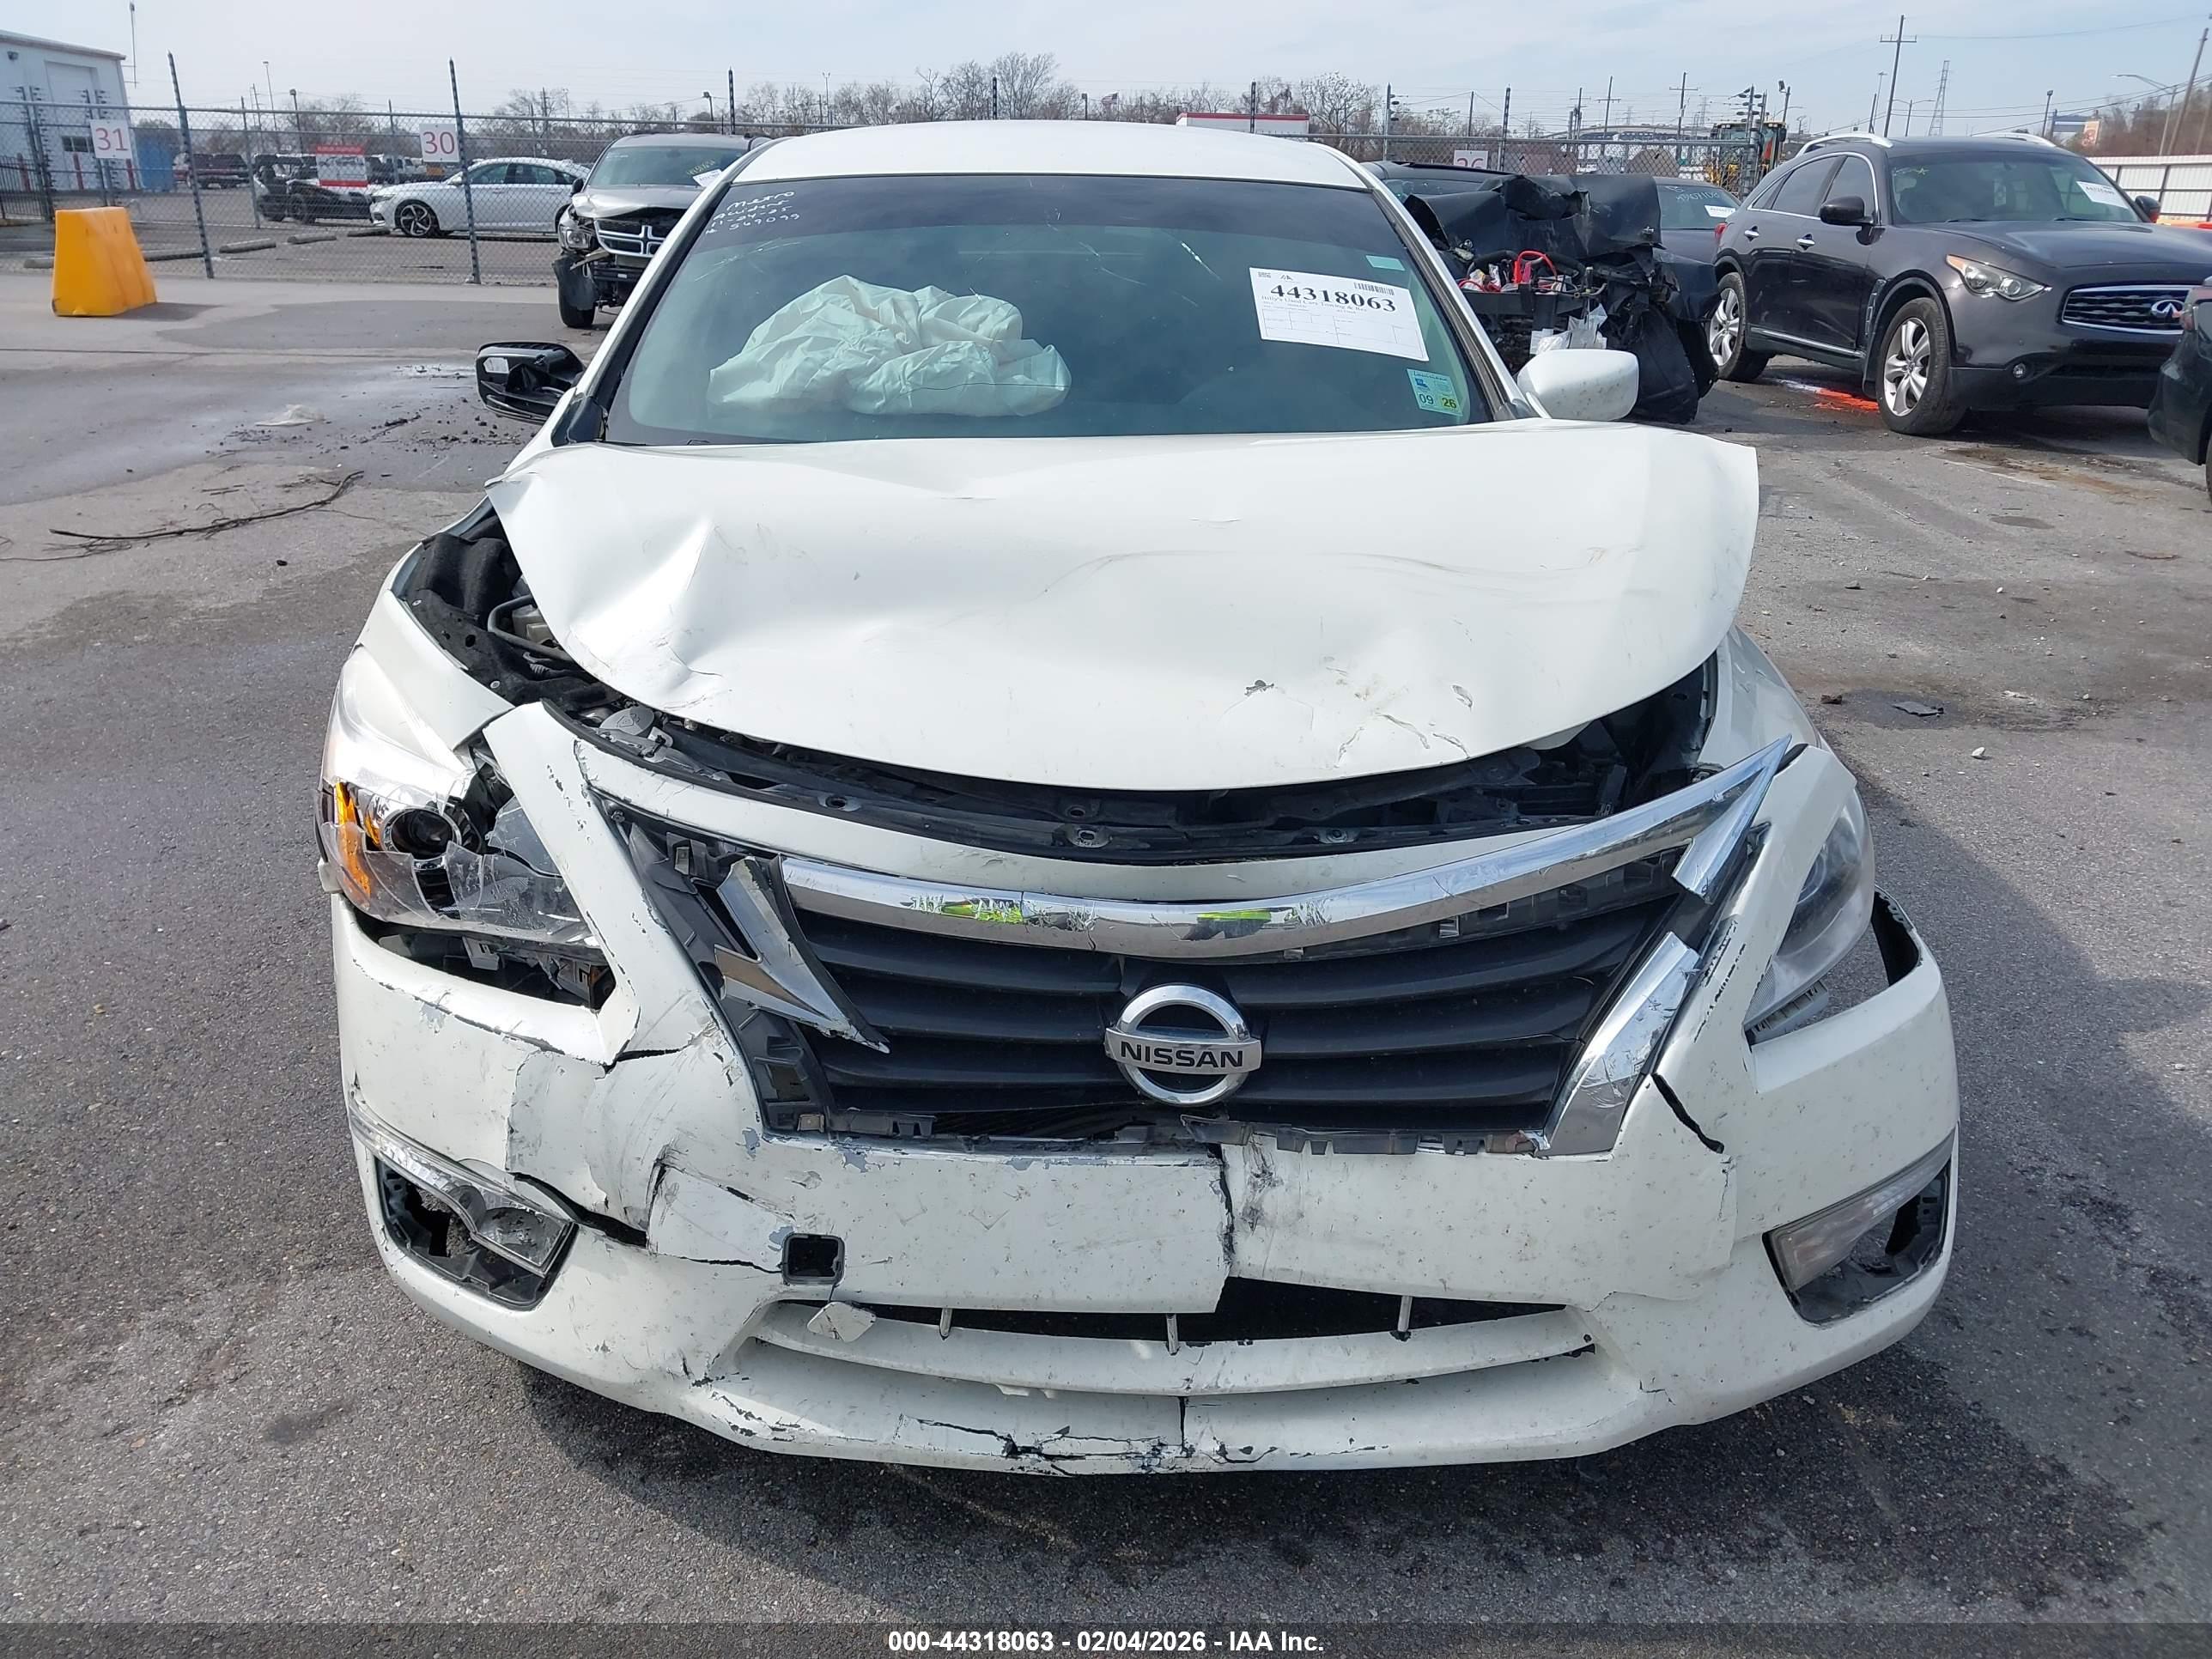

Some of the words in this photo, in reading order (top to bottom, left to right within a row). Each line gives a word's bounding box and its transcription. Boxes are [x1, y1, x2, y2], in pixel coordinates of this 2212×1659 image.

[94, 131, 128, 152] 31
[422, 131, 455, 154] 30
[1271, 284, 1396, 312] 44318063
[1419, 393, 1434, 405] 09
[1121, 1041, 1243, 1067] NISSAN
